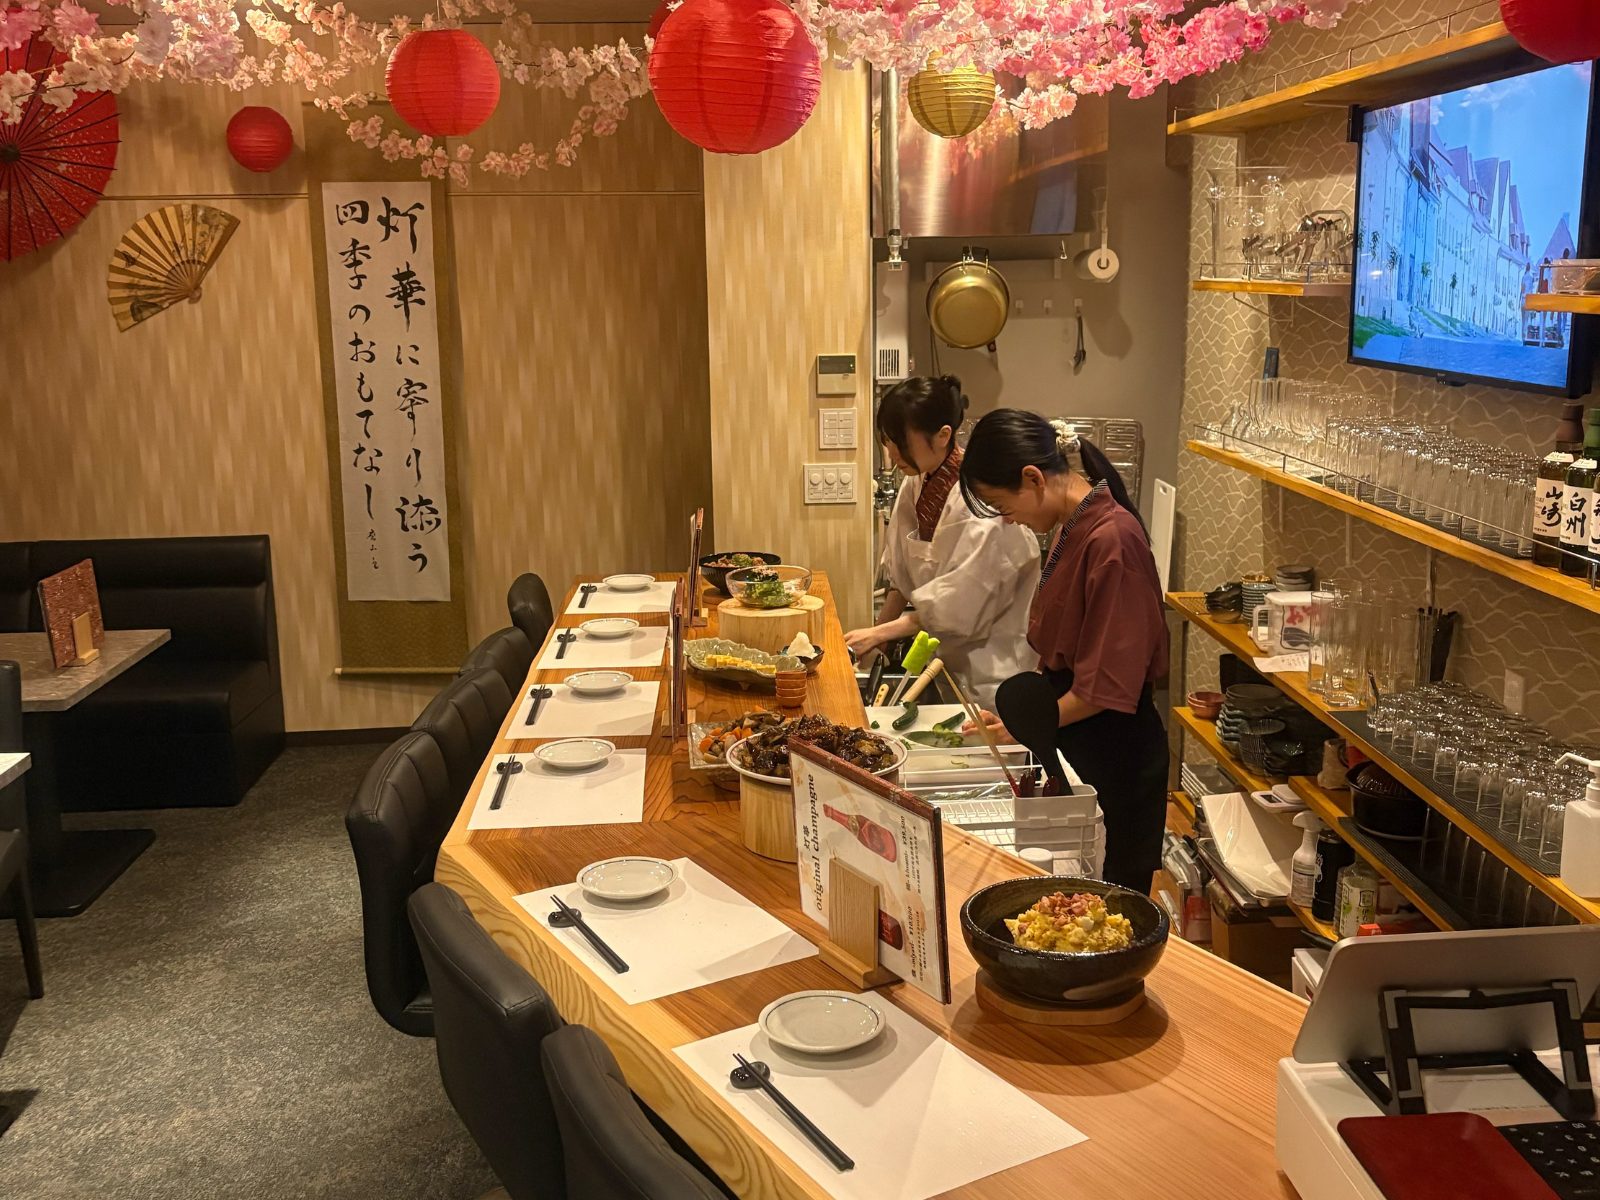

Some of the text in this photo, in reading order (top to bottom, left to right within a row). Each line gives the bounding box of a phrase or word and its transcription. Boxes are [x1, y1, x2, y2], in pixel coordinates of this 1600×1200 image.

[335, 200, 383, 520] 四季のおもてなし
[378, 196, 442, 573] 灯華に寄り添う
[1541, 486, 1563, 527] 山崎
[1566, 492, 1587, 538] 白州
[808, 774, 823, 911] original champagne
